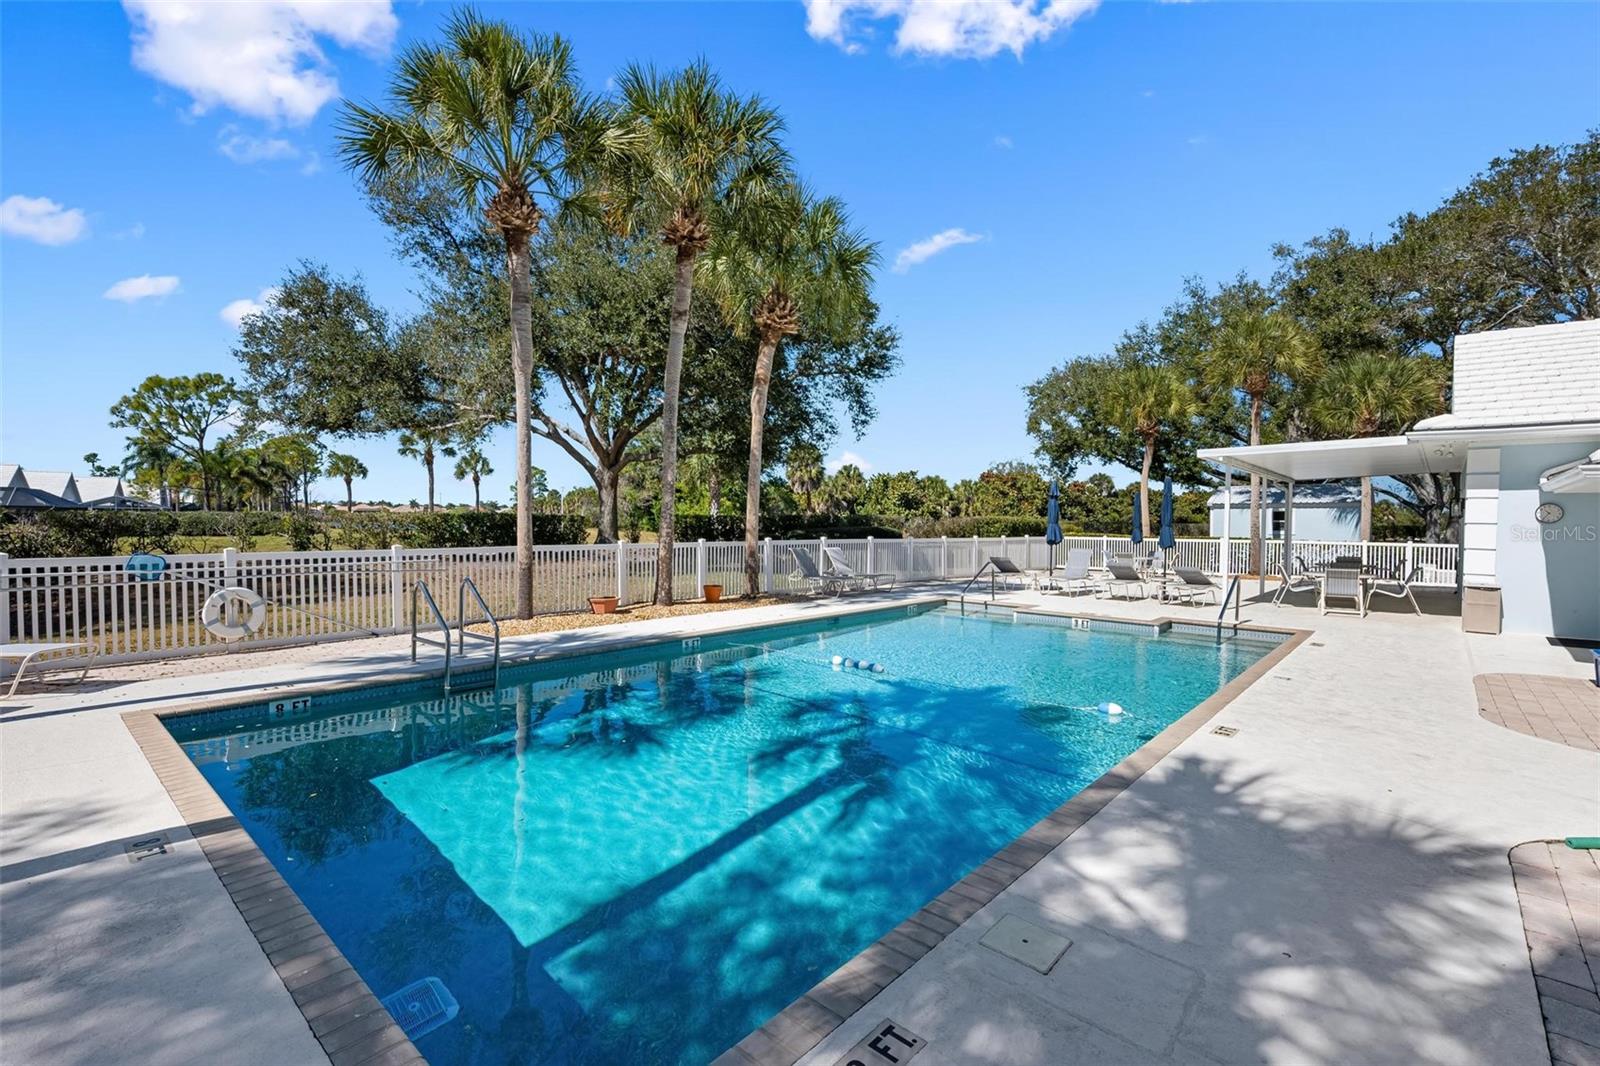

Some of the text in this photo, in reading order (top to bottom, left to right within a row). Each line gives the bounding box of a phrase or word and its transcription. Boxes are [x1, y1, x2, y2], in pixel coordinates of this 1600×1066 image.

[292, 699, 310, 713] FT
[132, 837, 161, 848] 8
[868, 1024, 918, 1064] FT.
